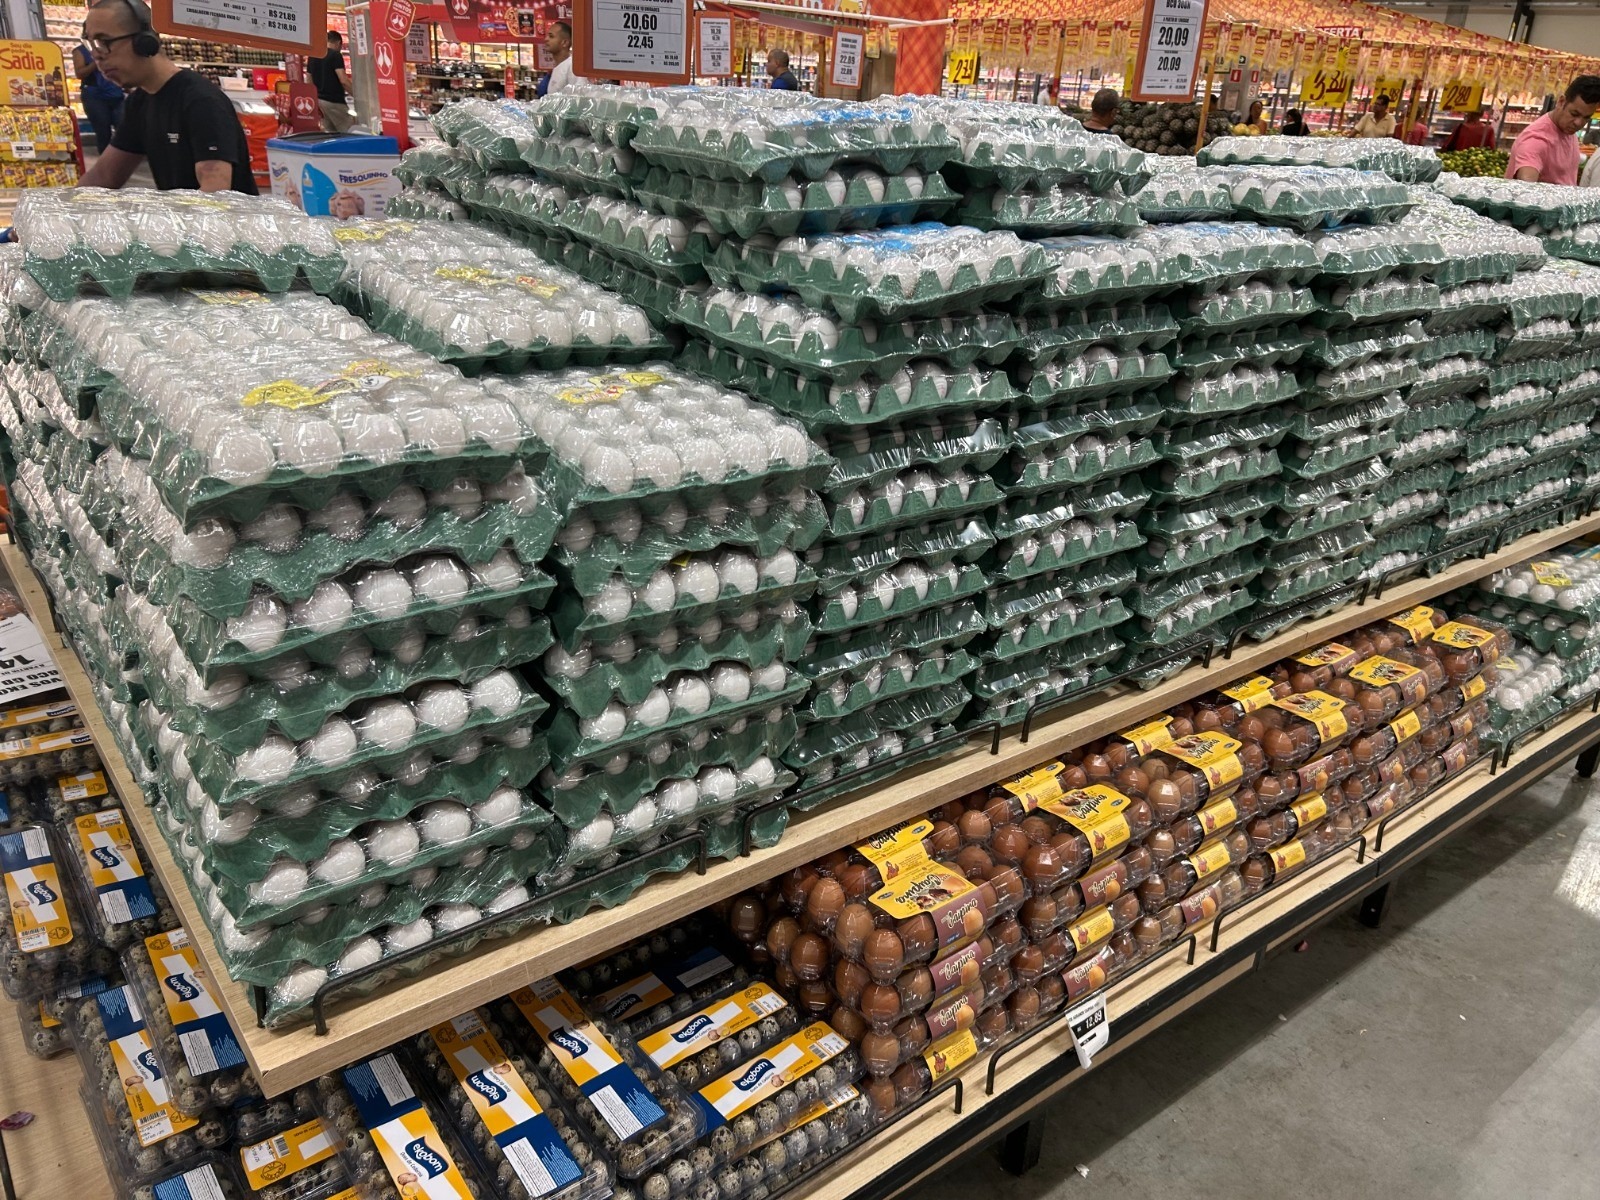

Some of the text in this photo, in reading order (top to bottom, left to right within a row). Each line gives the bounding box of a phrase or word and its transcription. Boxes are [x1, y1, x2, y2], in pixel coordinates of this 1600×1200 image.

[623, 12, 658, 31] 20,60
[627, 35, 653, 49] 22,45
[1158, 26, 1189, 47] 20,09
[0, 48, 45, 70] Sadia
[1157, 56, 1181, 72] 20,09
[339, 171, 389, 183] FRESQUINHO
[0, 678, 62, 696] VOS EKO
[1072, 794, 1107, 819] Caipira
[895, 874, 941, 903] Caipira
[1093, 871, 1117, 897] Caipira
[948, 898, 978, 928] Caipira
[945, 950, 975, 980] Caipira
[170, 976, 192, 998] ekobom
[940, 995, 968, 1026] Caipira
[1086, 1010, 1102, 1029] 12,89
[678, 1016, 708, 1039] ekobom
[553, 1032, 582, 1053] ekobom
[740, 1061, 769, 1087] ekobom
[471, 1075, 500, 1100] ekobom
[413, 1143, 443, 1172] ekobom
